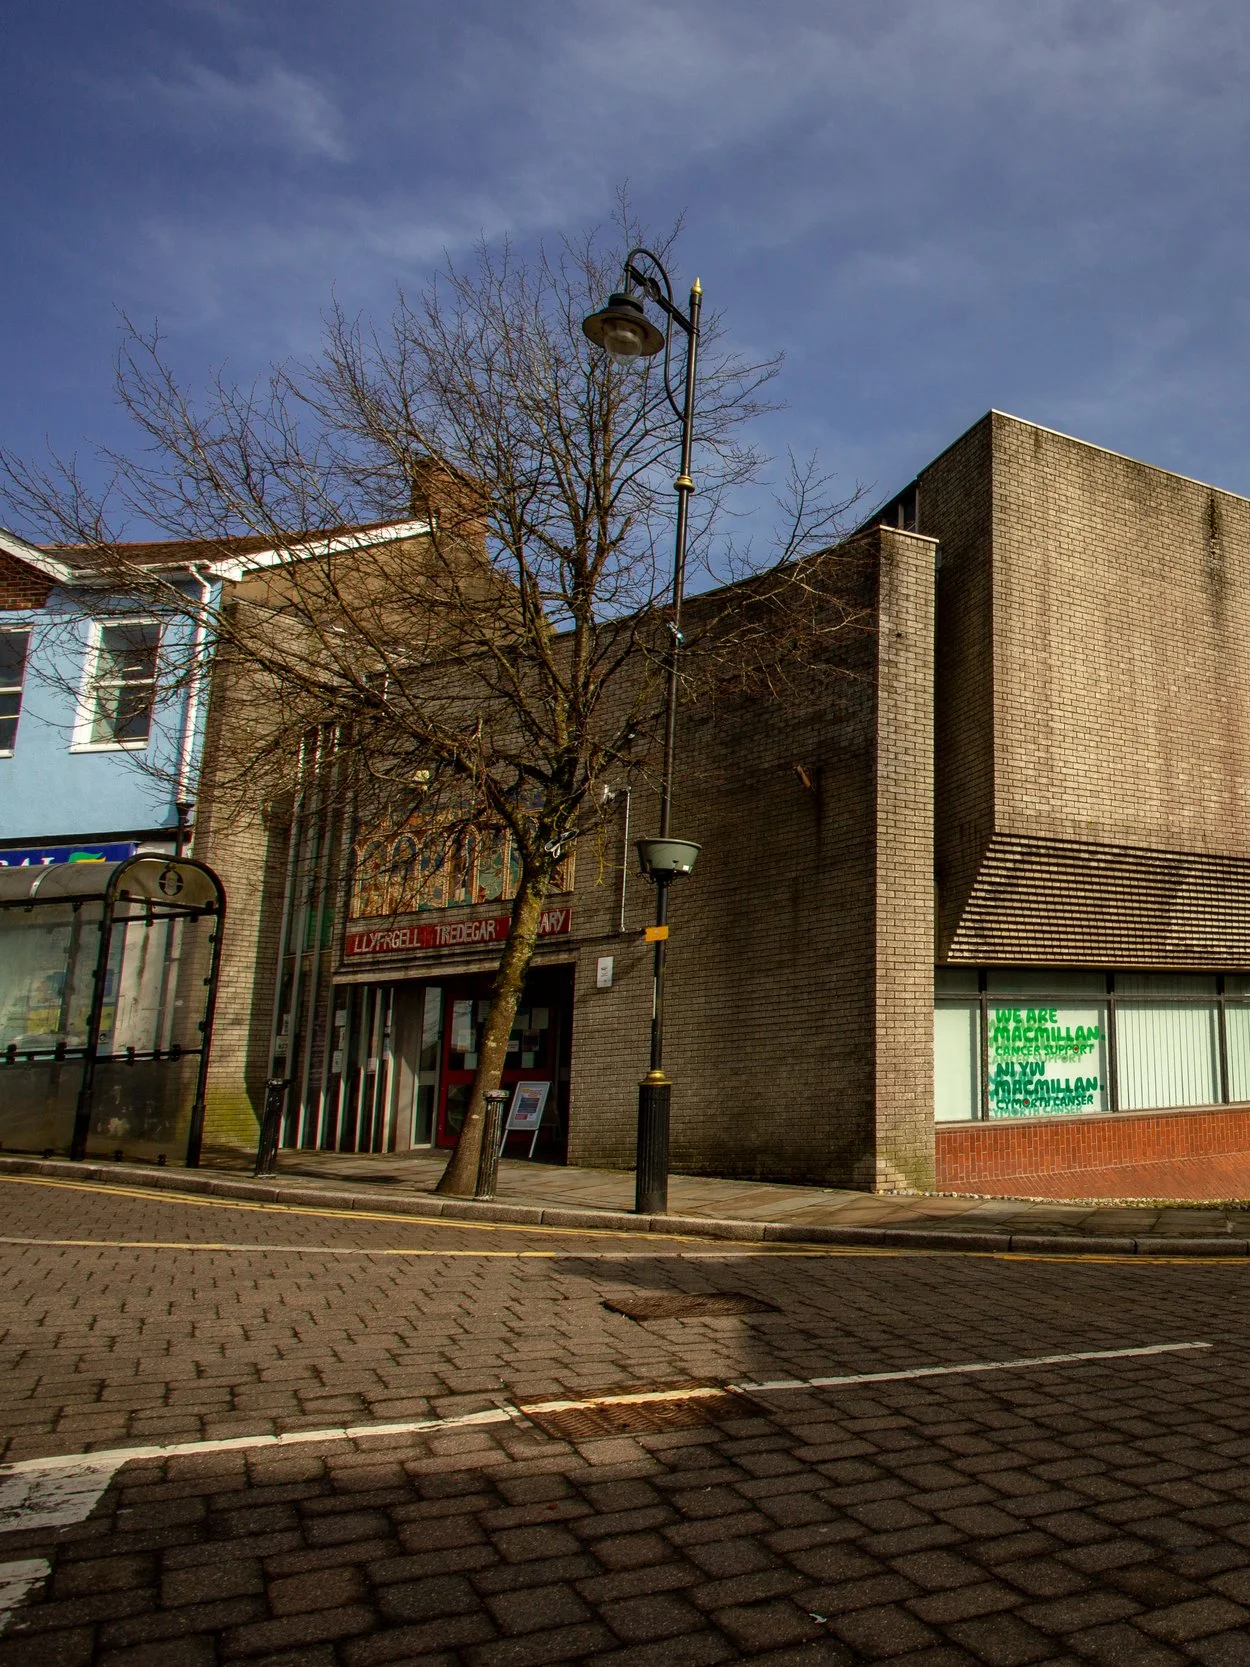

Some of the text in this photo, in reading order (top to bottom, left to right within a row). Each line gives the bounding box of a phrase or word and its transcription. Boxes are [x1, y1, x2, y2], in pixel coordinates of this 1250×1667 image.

[354, 929, 421, 953] LLYFRGELL
[434, 920, 496, 945] TREDEGAR
[995, 1008, 1058, 1024] WE ARE
[995, 1044, 1094, 1057] CANCER SUPPORT
[996, 1061, 1045, 1077] NI YW
[996, 1095, 1094, 1110] CYMORTH CANSER
